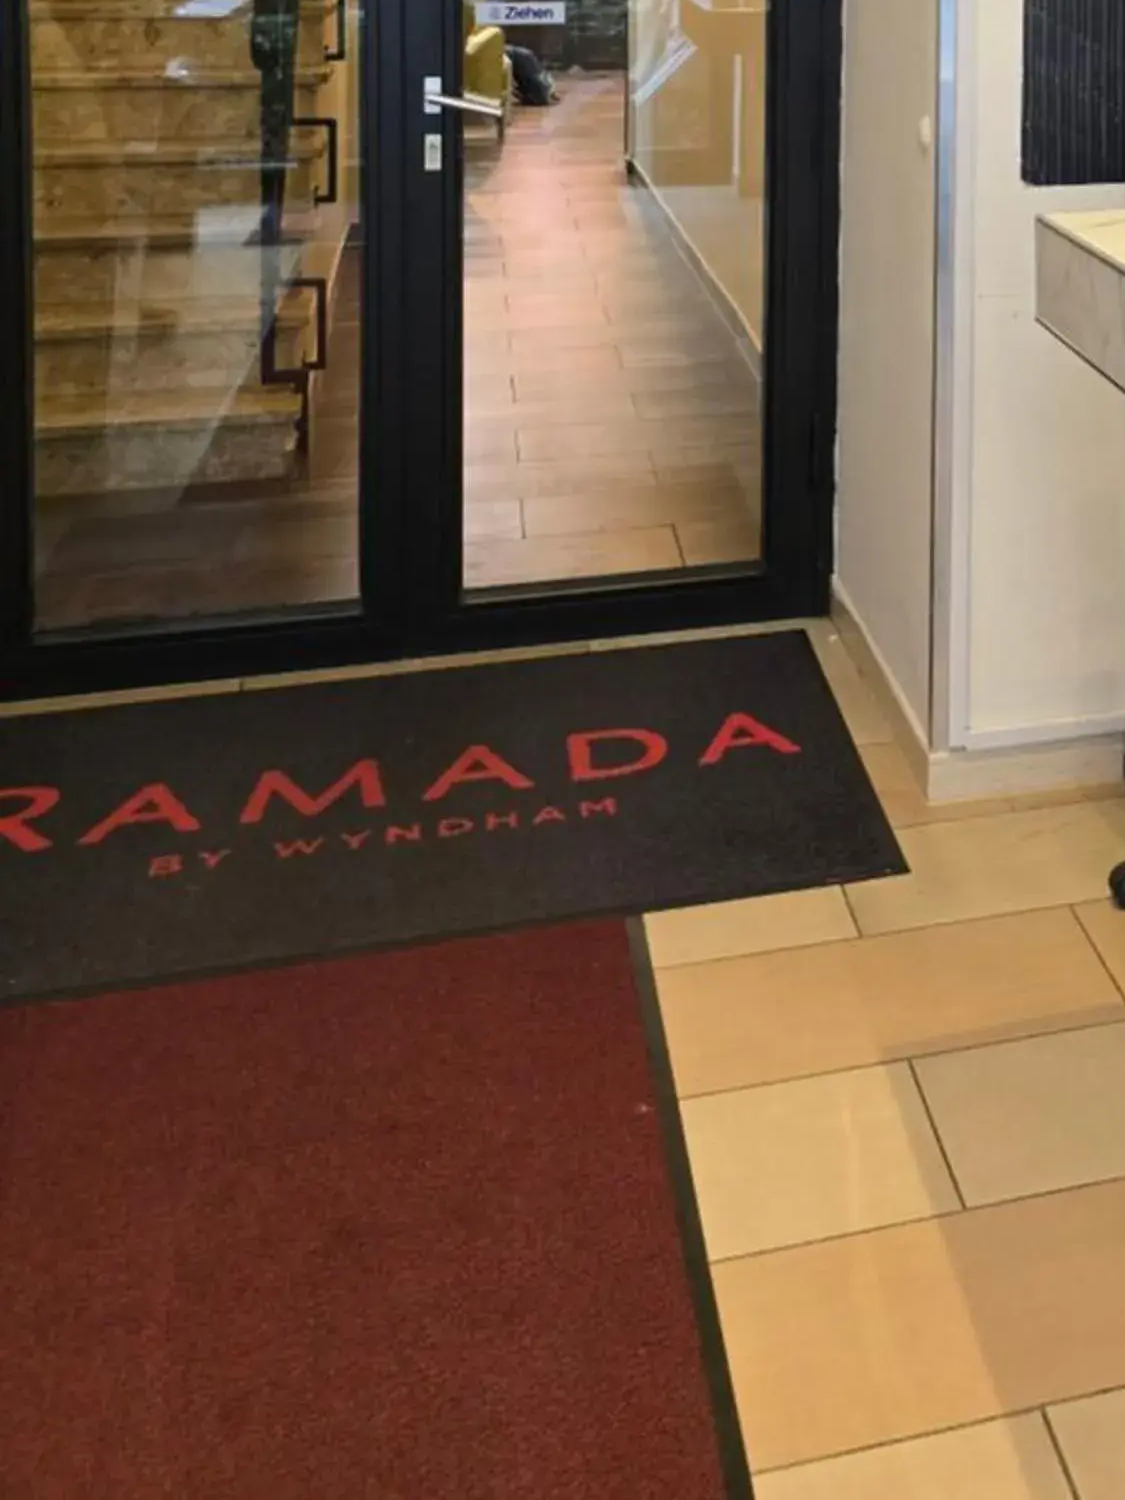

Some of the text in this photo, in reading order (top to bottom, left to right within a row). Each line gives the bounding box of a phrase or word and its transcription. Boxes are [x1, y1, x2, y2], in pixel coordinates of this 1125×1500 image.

[504, 5, 555, 20] Ziehen
[0, 711, 801, 853] RAMADA
[148, 797, 619, 877] BY WYNDHAM
